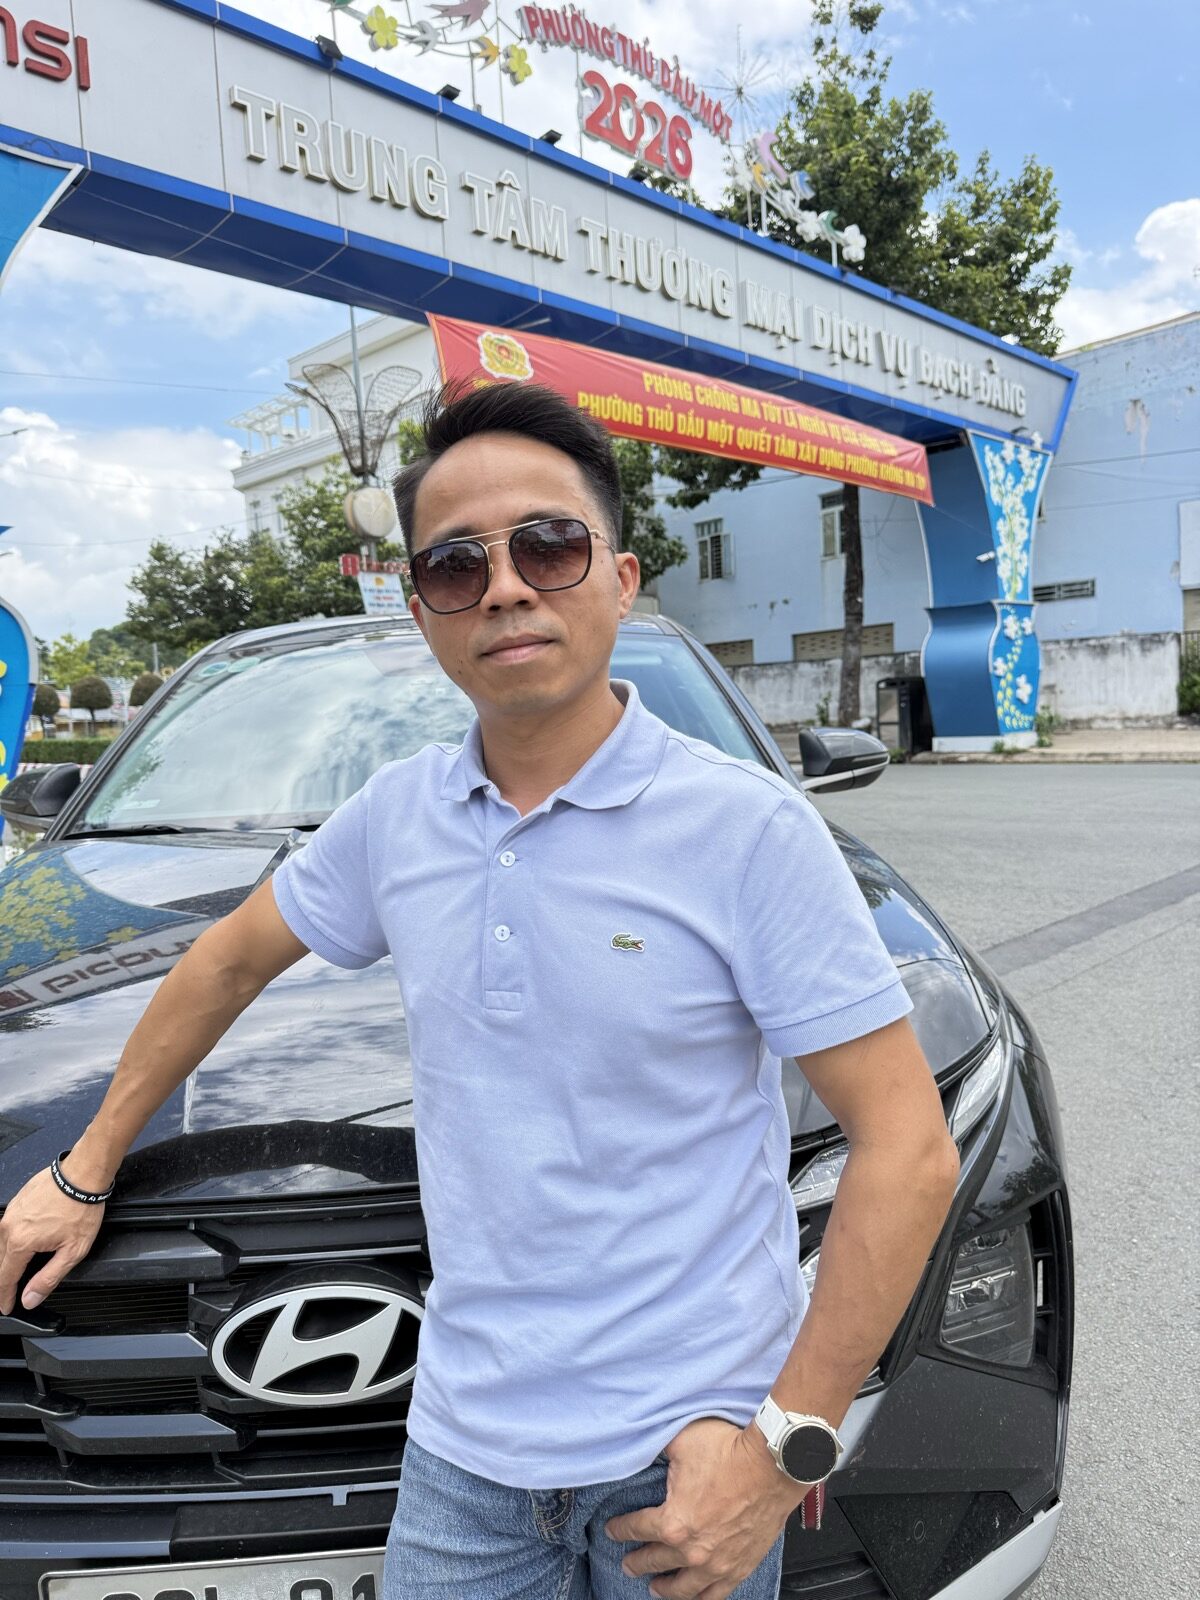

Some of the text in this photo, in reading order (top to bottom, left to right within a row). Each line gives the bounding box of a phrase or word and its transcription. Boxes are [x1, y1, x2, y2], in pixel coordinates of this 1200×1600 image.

[581, 70, 692, 180] 2026
[229, 85, 448, 221] TRUNG
[460, 170, 568, 261] TÂM
[577, 217, 735, 318] THƯƠNG
[740, 279, 802, 349] MẠI
[811, 304, 873, 366] DỊCH
[878, 331, 912, 389] VỤ
[918, 350, 972, 399] BẠCH
[577, 391, 643, 427] PHƯỜNG
[646, 403, 674, 433] THỦ
[677, 408, 704, 439] DẦU
[707, 416, 734, 449] MỘT
[736, 424, 772, 453] QUYẾT
[643, 371, 692, 403] PHÒNG
[696, 384, 740, 415] CHỐNG
[741, 396, 761, 419] MA
